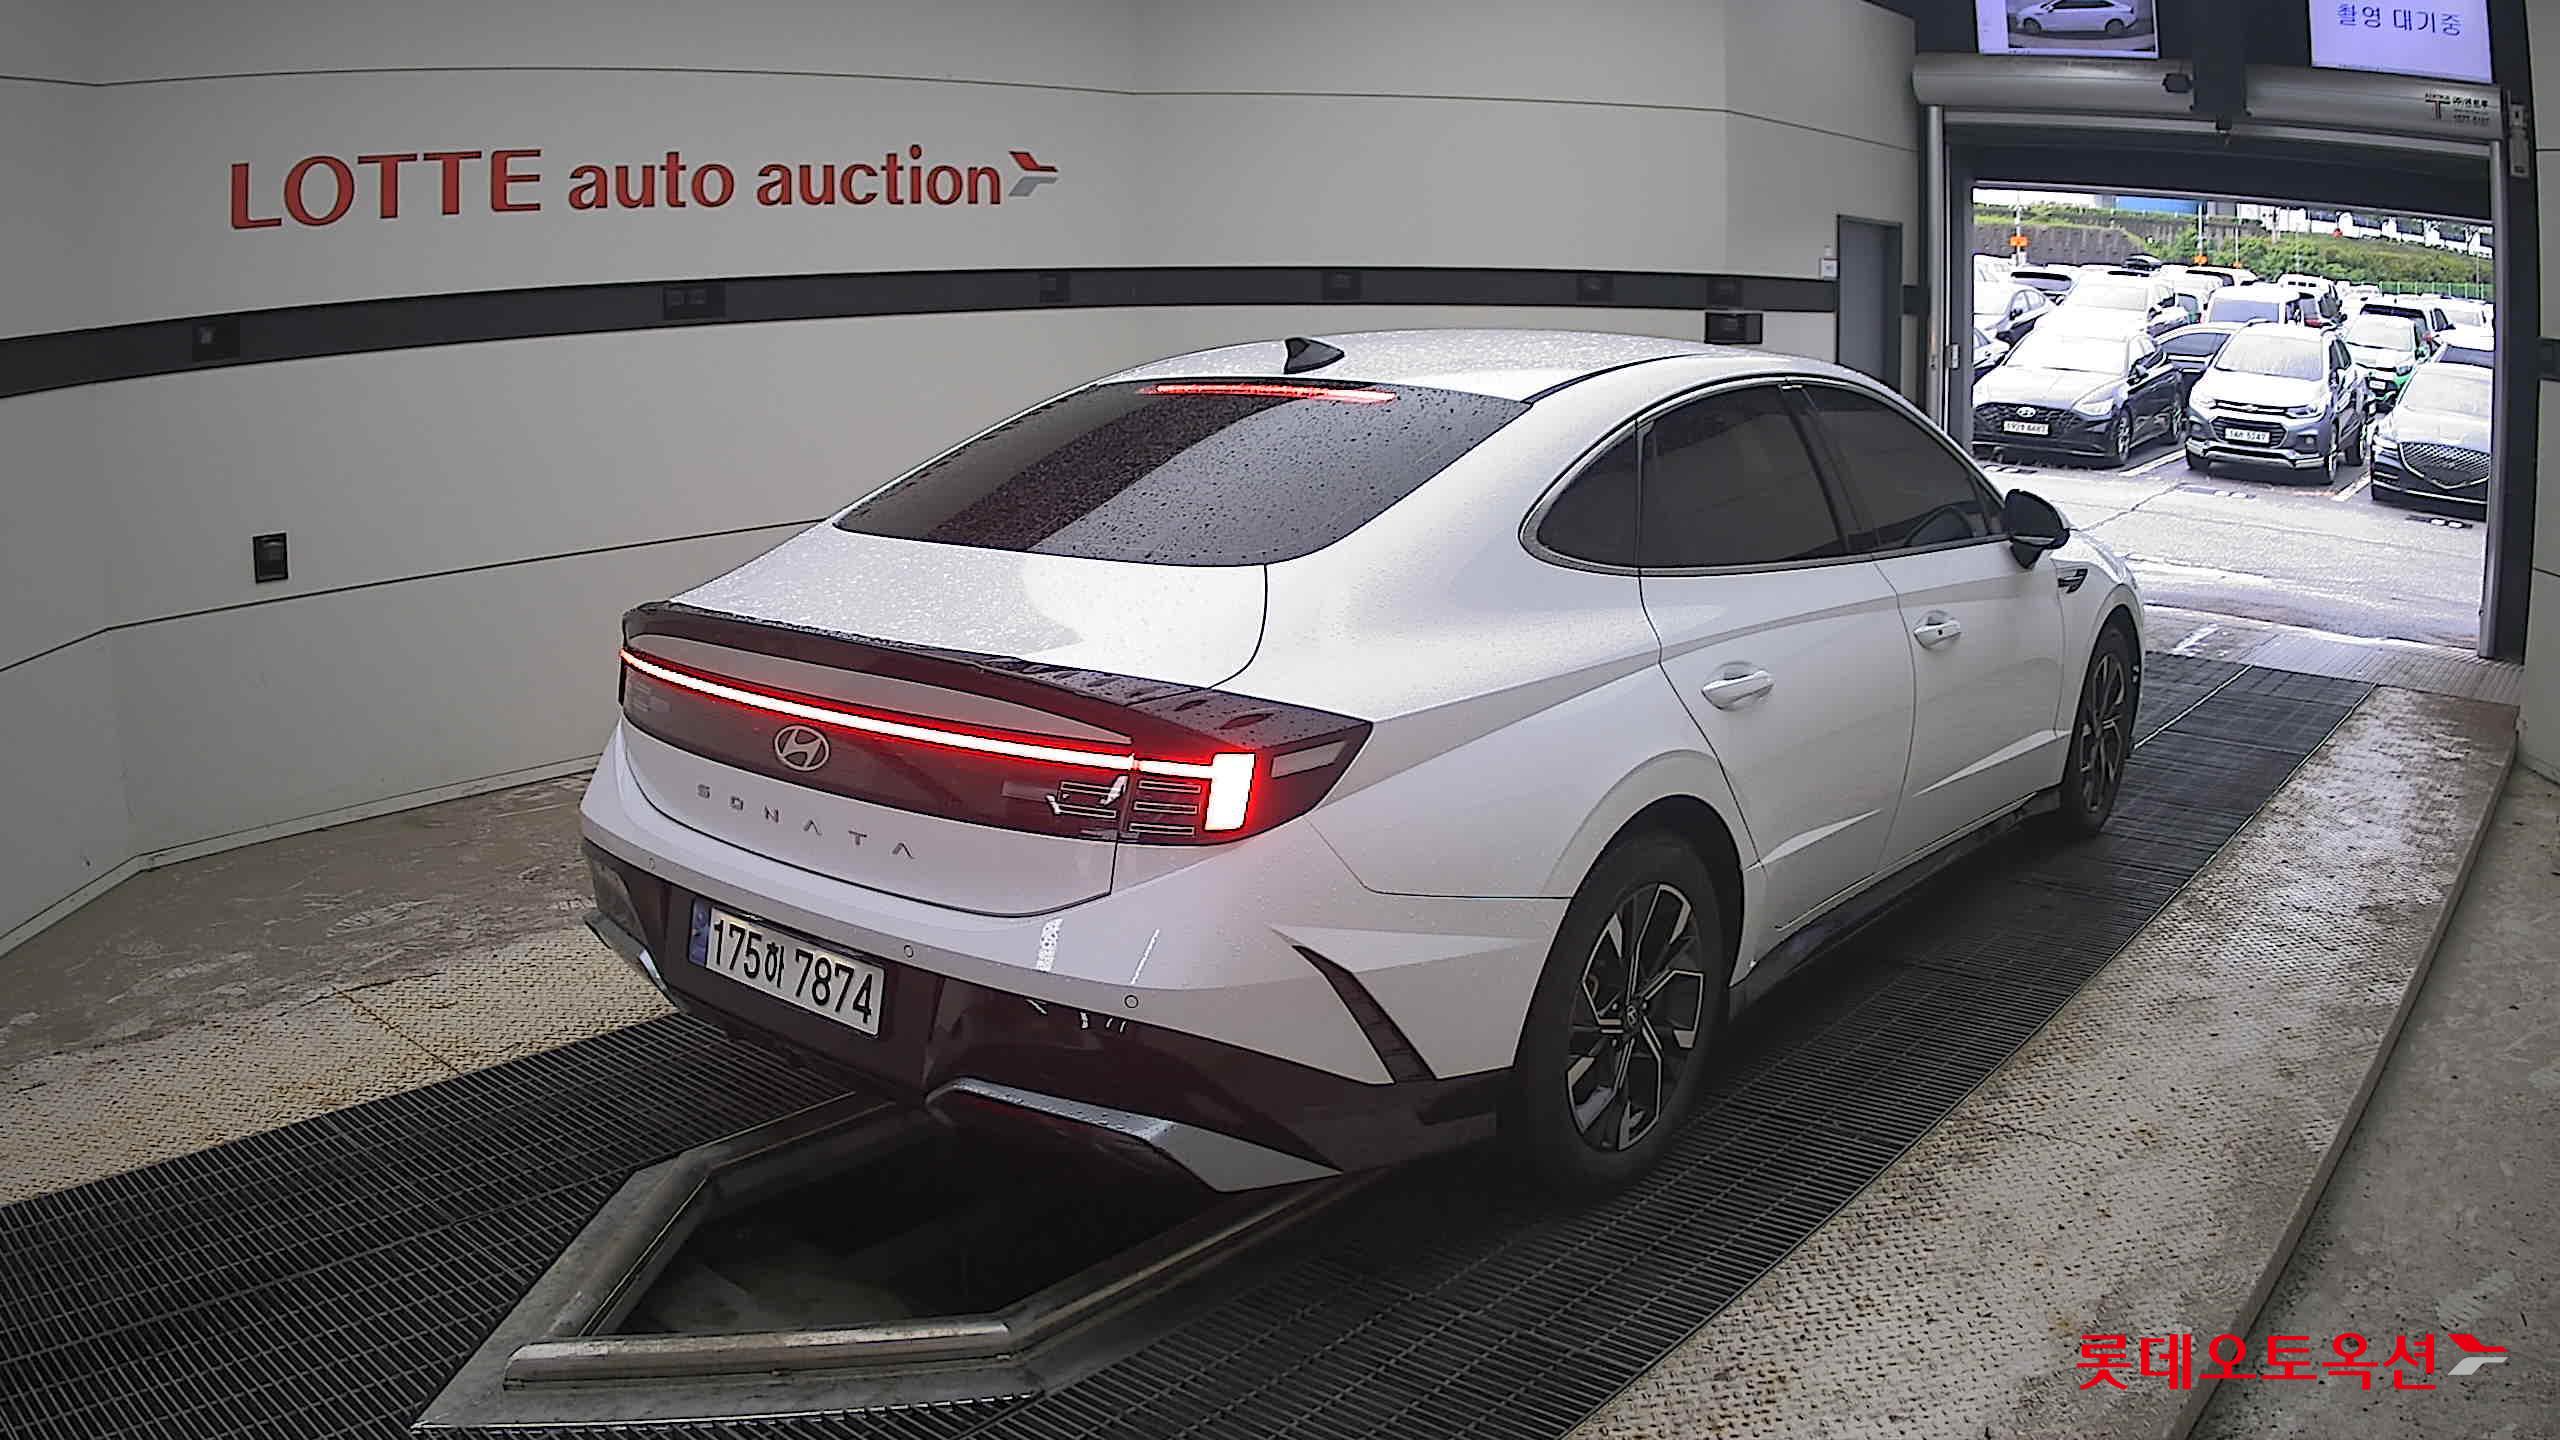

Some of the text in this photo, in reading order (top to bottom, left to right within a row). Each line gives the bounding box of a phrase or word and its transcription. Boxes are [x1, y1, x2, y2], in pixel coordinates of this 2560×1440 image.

[2337, 3, 2463, 36] 촬영 대기중
[230, 144, 1001, 230] LOTTE auto auction
[697, 783, 915, 859] SONATA
[714, 919, 873, 1024] 175하 7874
